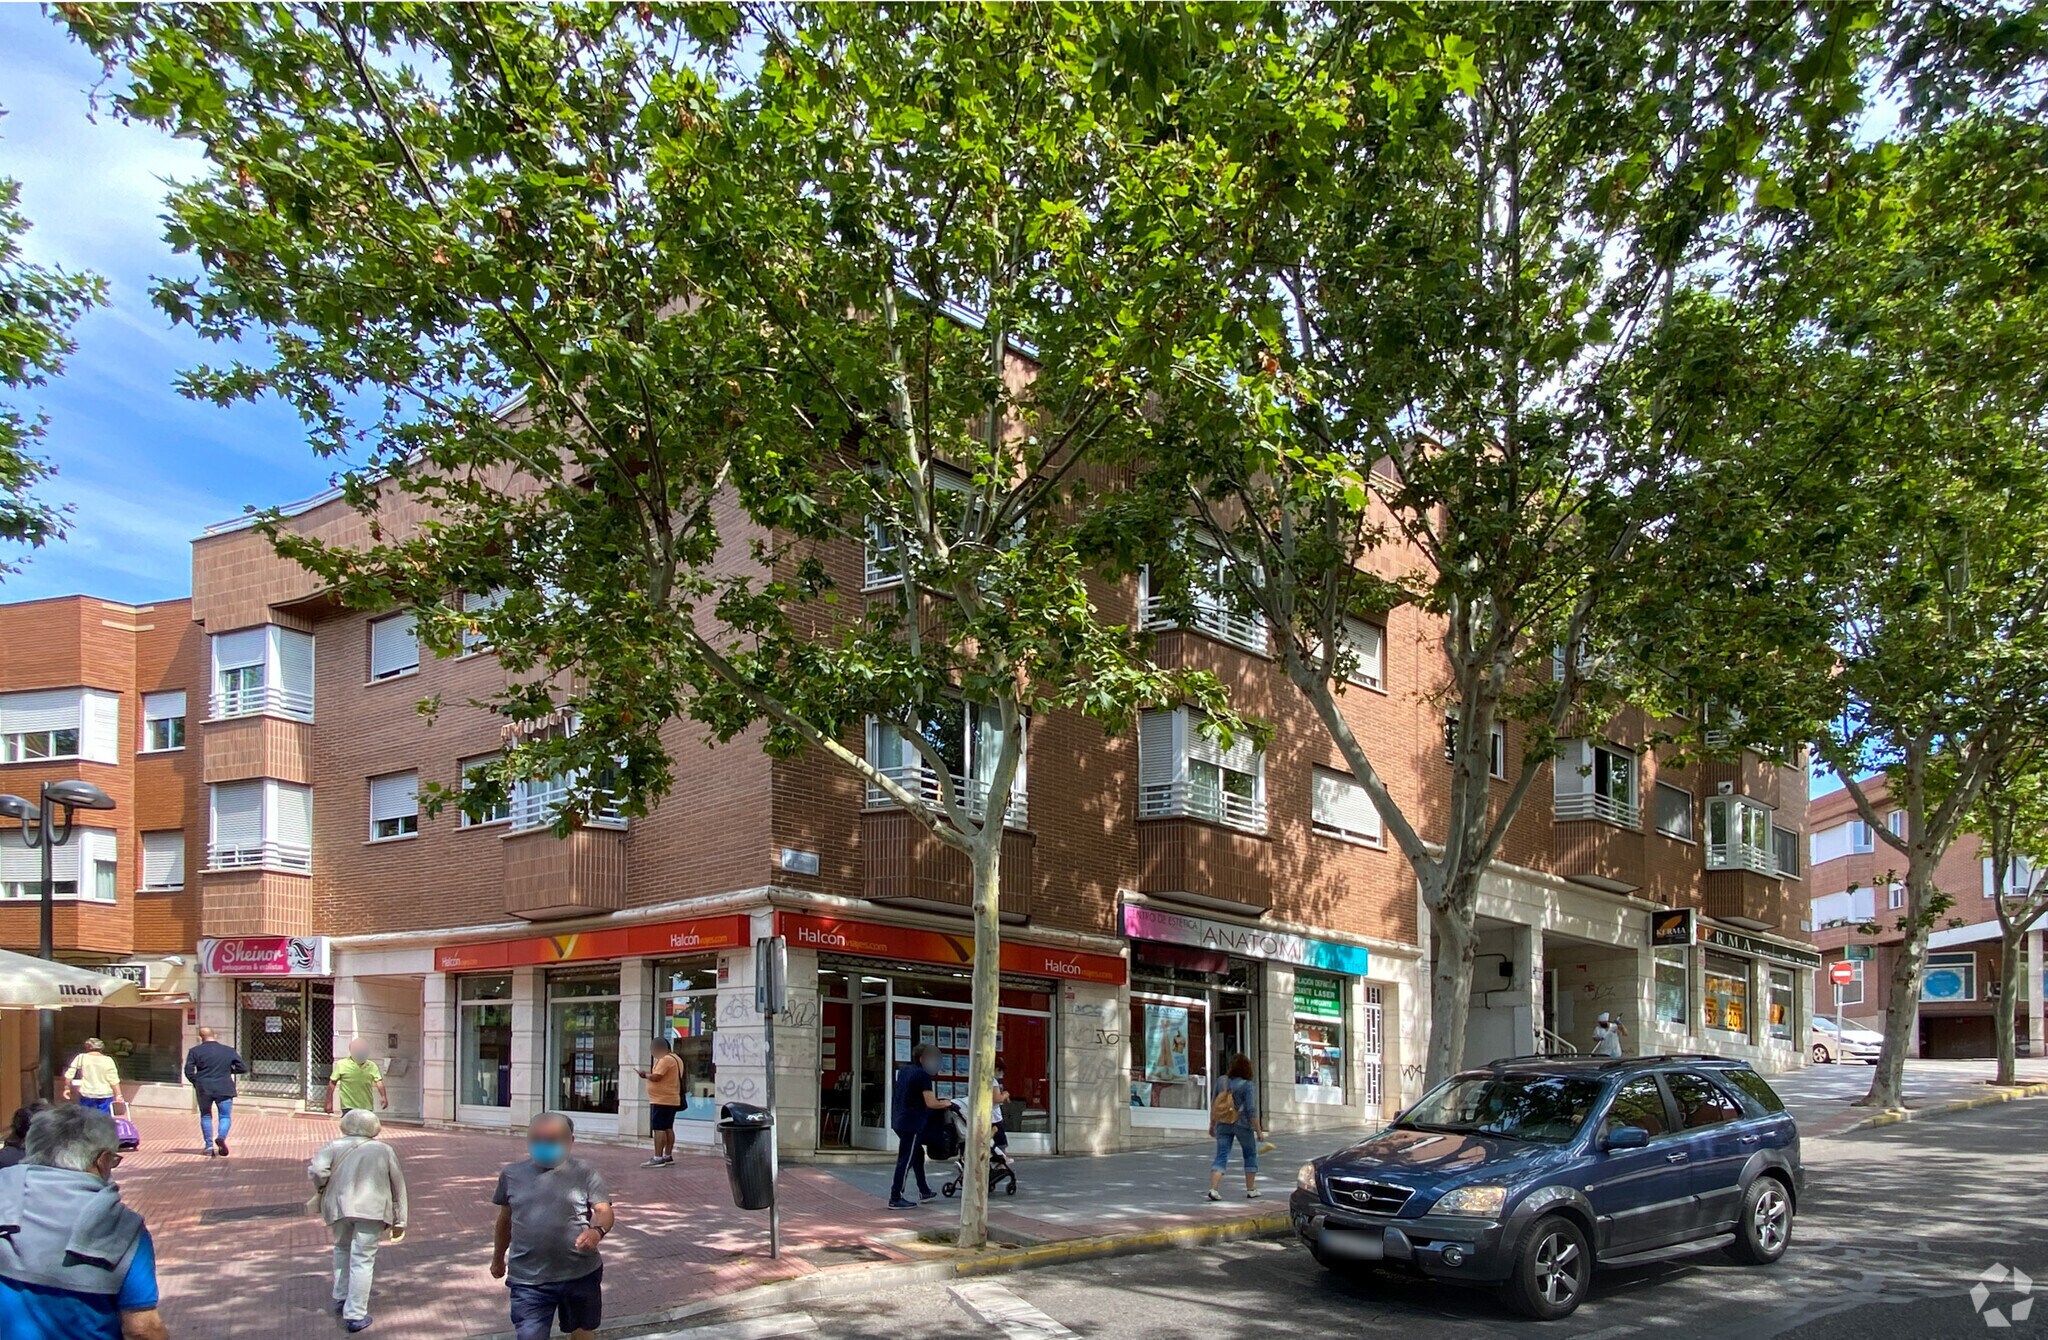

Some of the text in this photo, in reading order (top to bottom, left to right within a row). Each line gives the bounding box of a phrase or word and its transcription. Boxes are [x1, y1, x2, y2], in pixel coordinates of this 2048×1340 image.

[670, 926, 700, 947] Halcón
[798, 924, 846, 947] Halcón
[1203, 927, 1301, 959] ANATOMI
[1704, 928, 1752, 952] ERMA
[222, 941, 284, 963] Sheinor
[1045, 956, 1081, 975] Halcón
[1313, 989, 1336, 999] LASER
[1353, 1192, 1368, 1200] KIA
